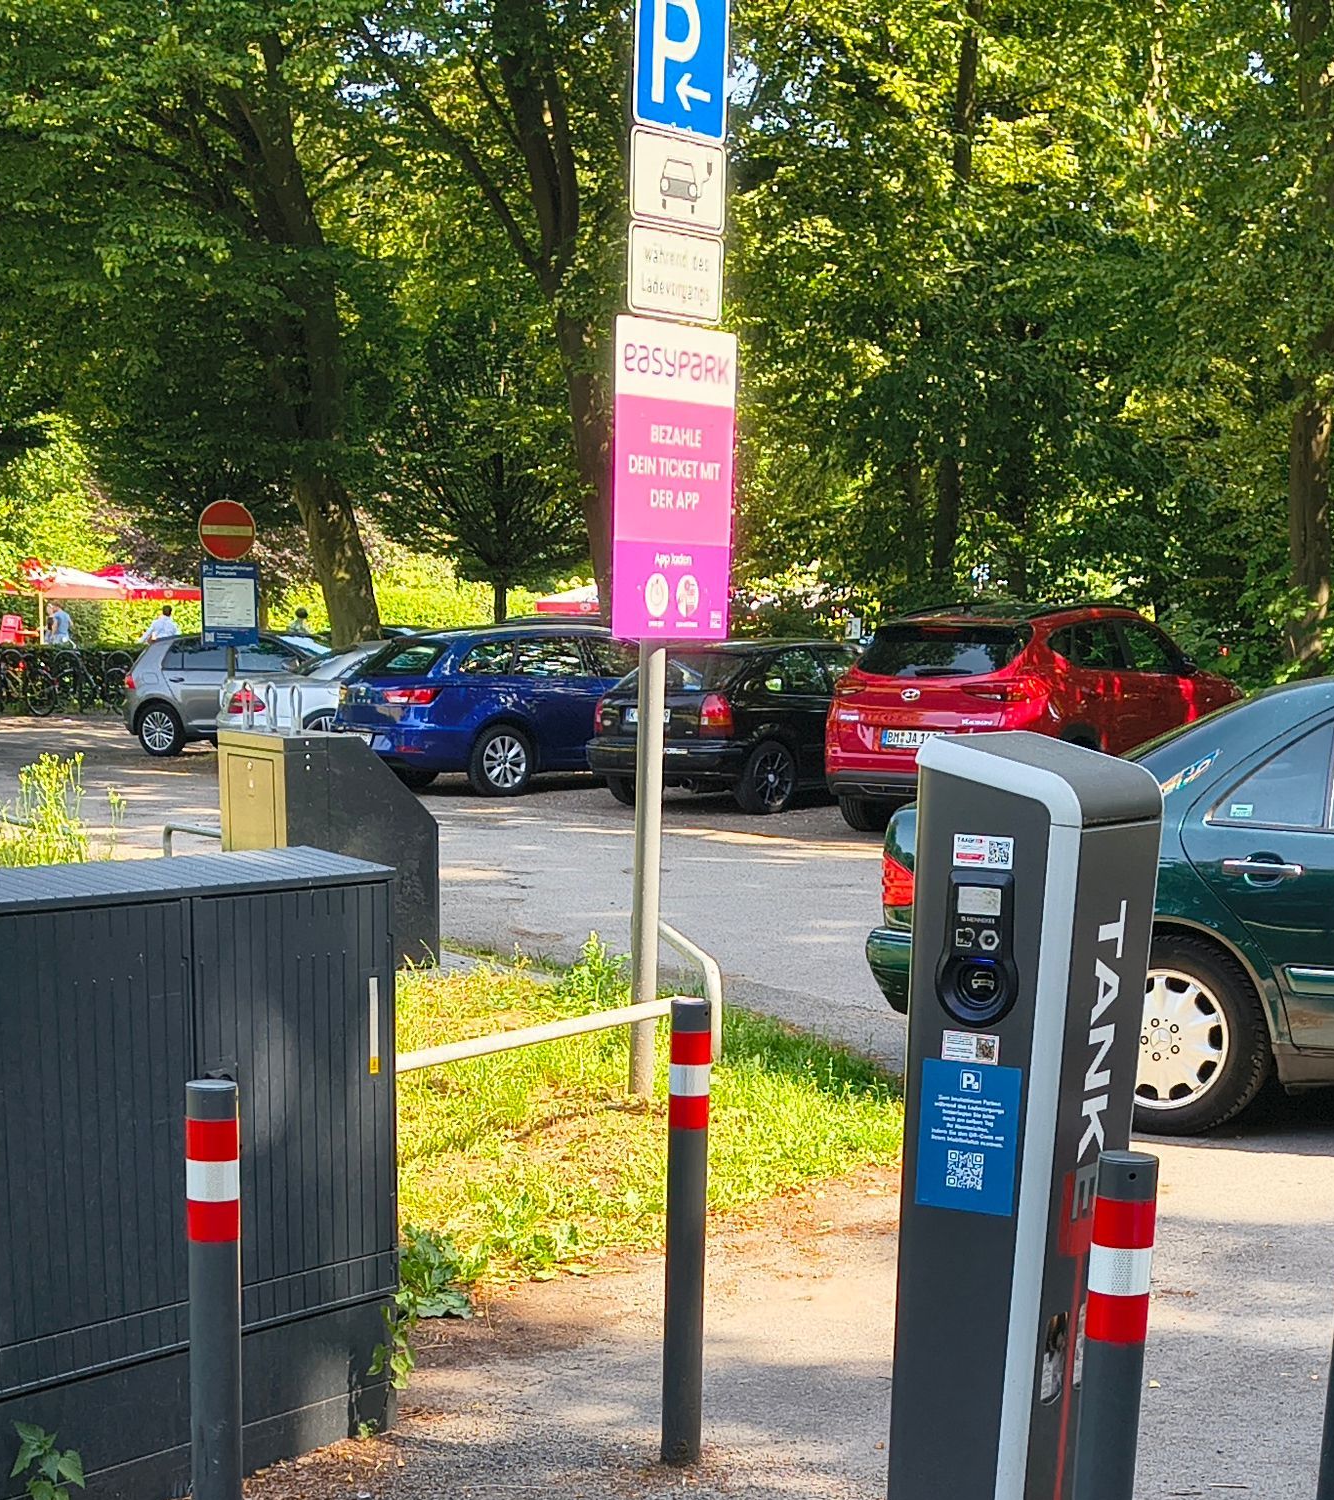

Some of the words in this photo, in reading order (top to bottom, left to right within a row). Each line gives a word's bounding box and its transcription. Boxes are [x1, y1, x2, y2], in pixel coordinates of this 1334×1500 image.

[651, 0, 701, 104] P
[650, 424, 702, 448] BEZAHLE
[628, 454, 657, 476] DEIN
[658, 457, 699, 479] TICKET
[700, 462, 721, 481] MIT
[650, 488, 674, 509] DER
[676, 490, 700, 511] APP
